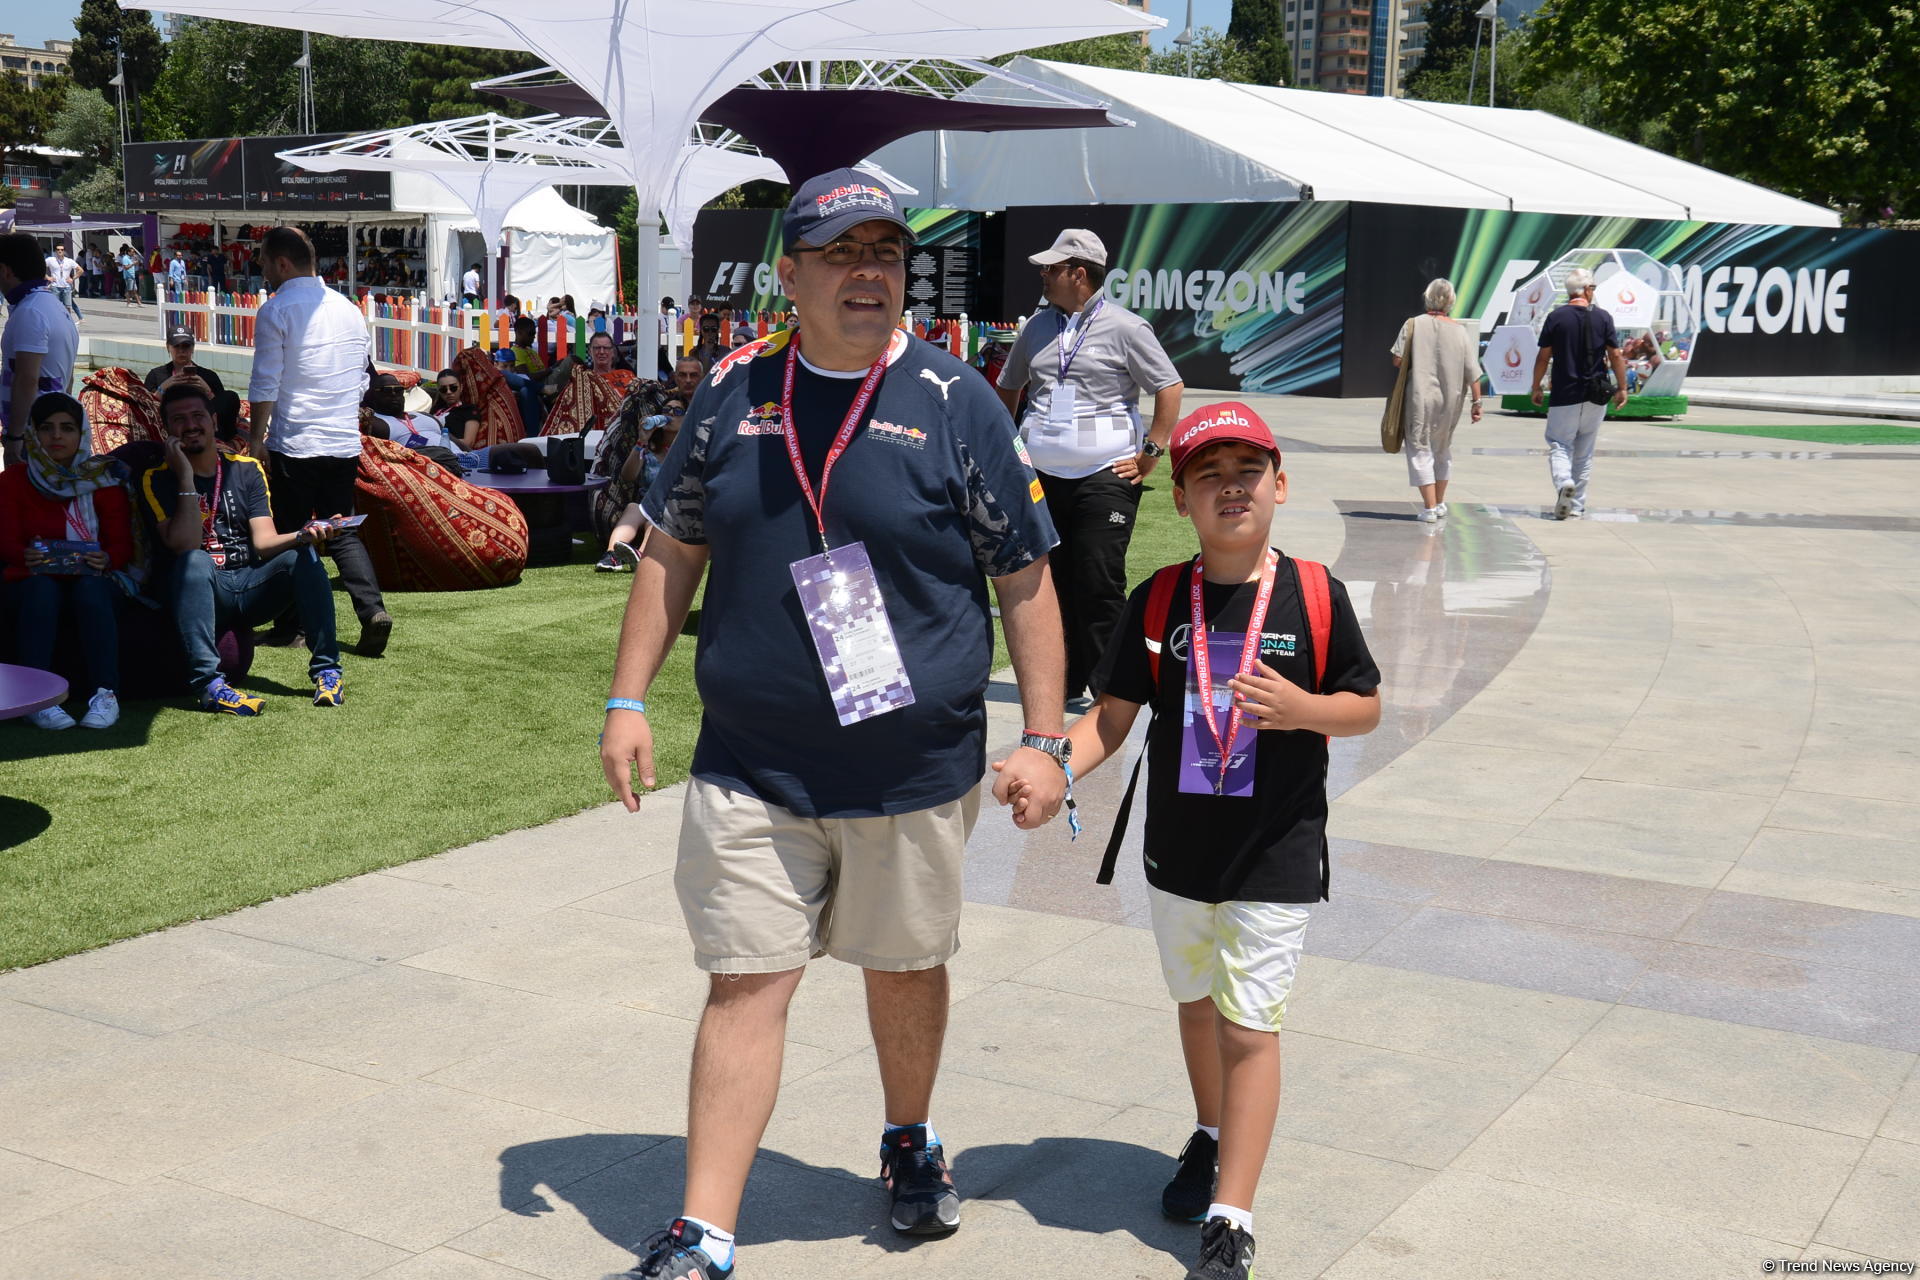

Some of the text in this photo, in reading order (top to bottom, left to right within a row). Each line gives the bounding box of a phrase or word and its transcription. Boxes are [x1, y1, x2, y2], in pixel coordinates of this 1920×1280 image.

[1103, 267, 1306, 315] GAMEZONE
[841, 391, 870, 442] AZERBAIJAN
[864, 365, 883, 392] GRAND
[1180, 409, 1249, 446] LEGOLAND
[1193, 602, 1203, 642] FORMULA
[1252, 600, 1267, 629] GRAND
[1260, 581, 1272, 599] PRIX
[1197, 650, 1210, 703] AZERBAIJAN
[1276, 649, 1295, 657] TEAM
